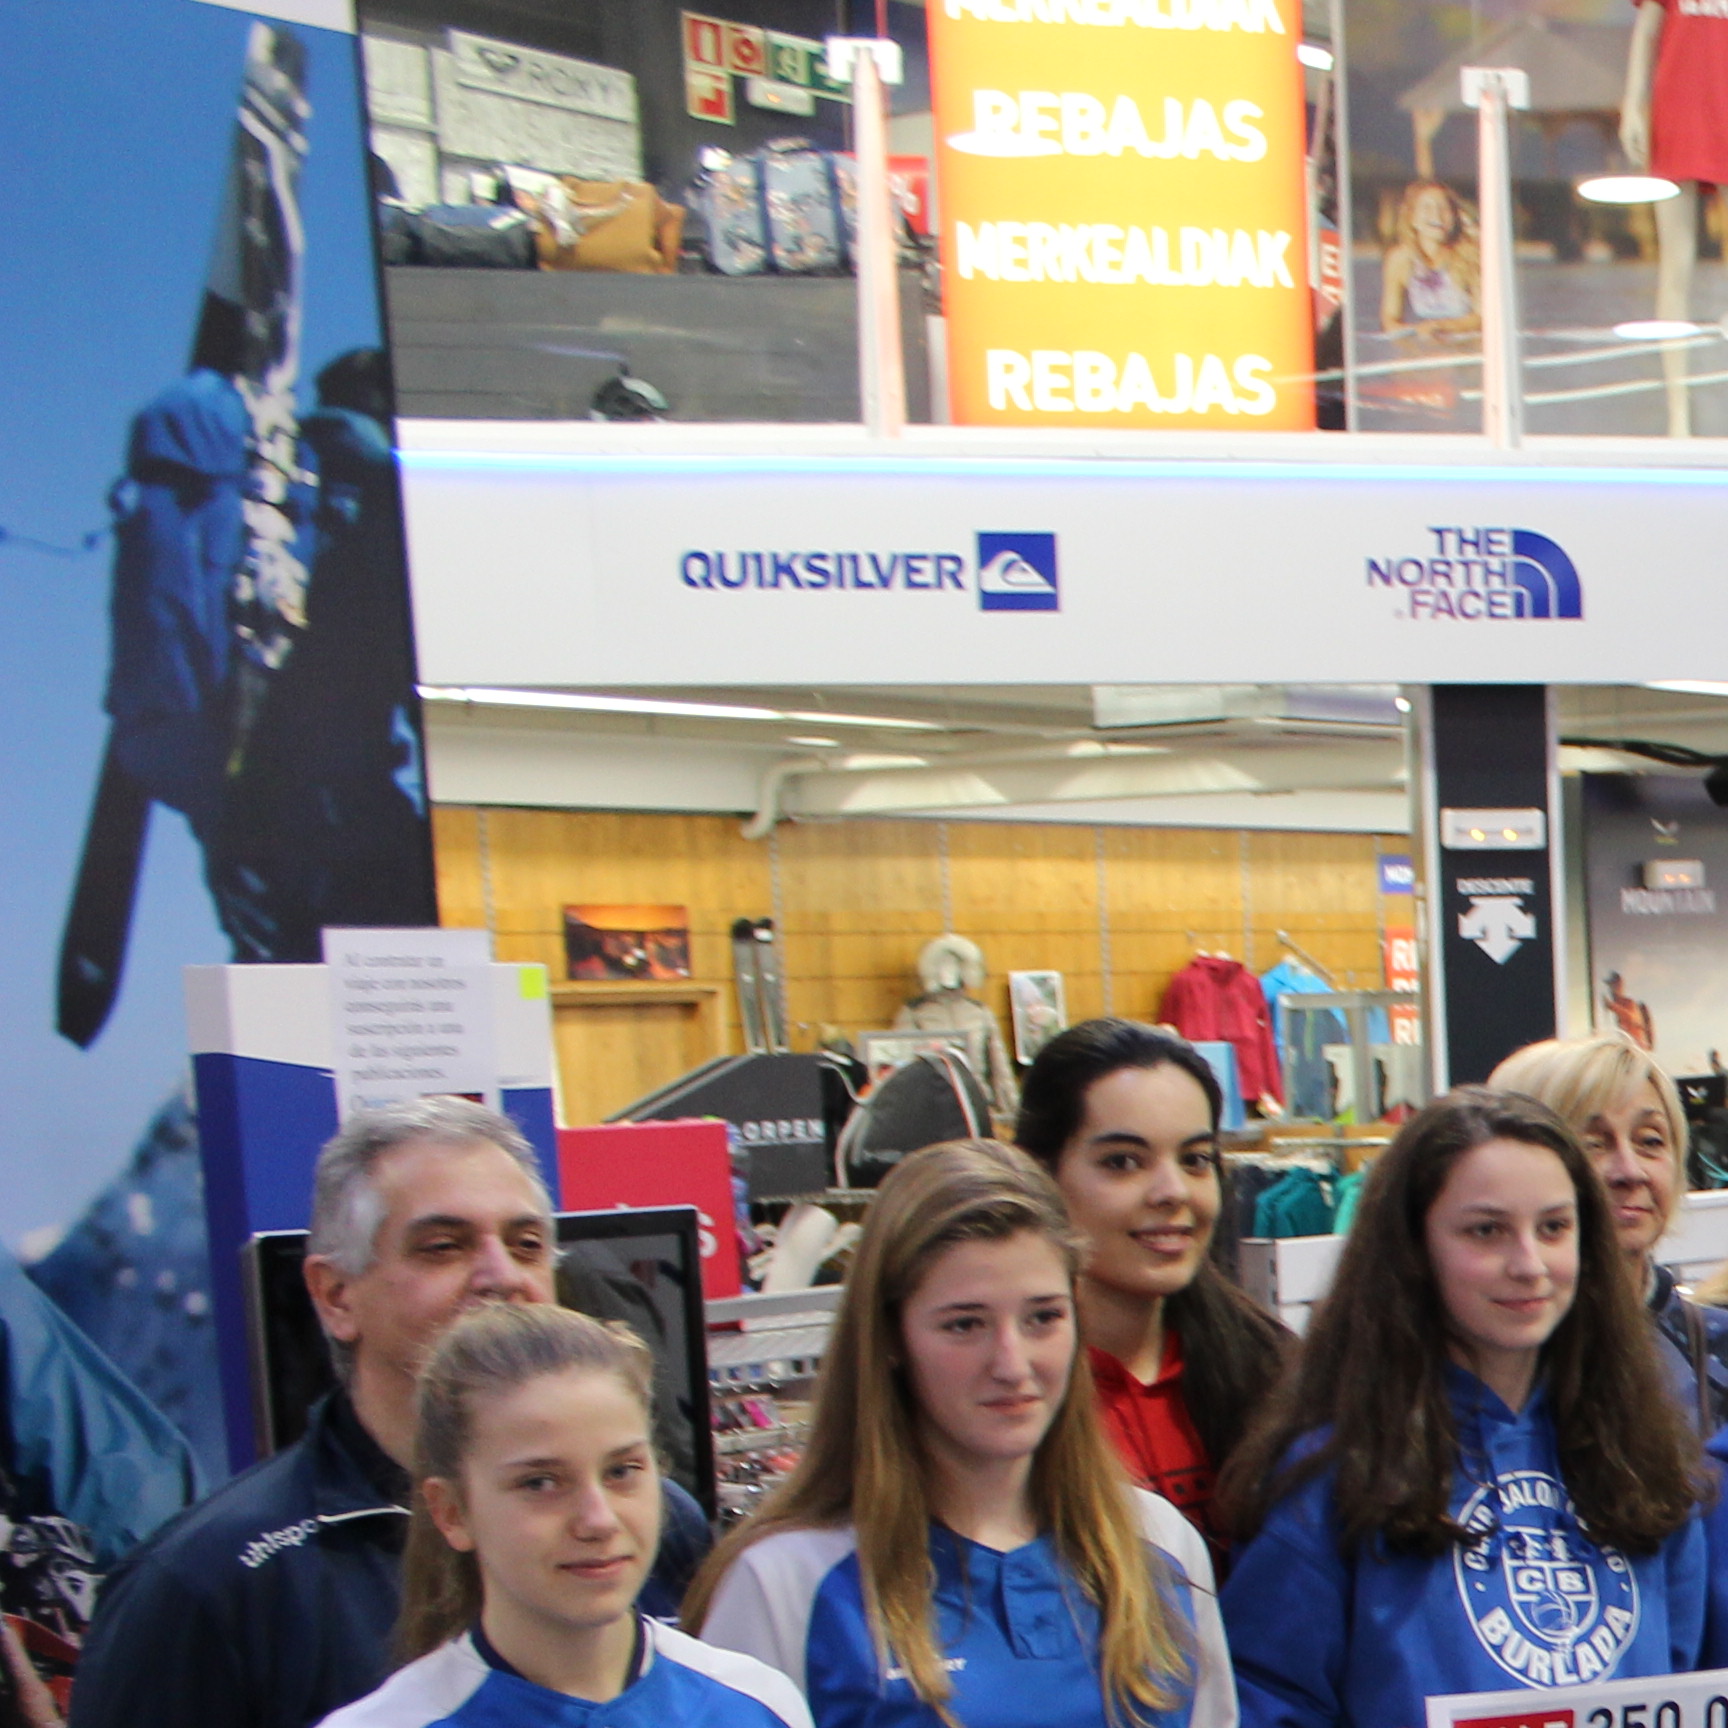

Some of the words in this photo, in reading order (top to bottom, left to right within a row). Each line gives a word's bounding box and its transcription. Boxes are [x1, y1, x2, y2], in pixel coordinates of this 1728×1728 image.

[972, 90, 1268, 162] REBAJAS
[956, 221, 1294, 289] MERKEALDIAK
[986, 350, 1277, 416] REBAJAS
[1428, 526, 1509, 556] THE
[679, 551, 966, 591] QUIKSILVER
[1366, 559, 1509, 589] NORTH
[1410, 591, 1509, 620] FACE
[1456, 877, 1535, 896] DESCENTE
[1620, 888, 1717, 915] MOUNTAIN
[343, 975, 380, 993] viaje
[382, 978, 406, 990] con
[410, 977, 467, 990] nosotros
[742, 1119, 825, 1140] ORPEN
[239, 1516, 319, 1569] uhlspo
[1478, 1604, 1634, 1686] BURLADA
